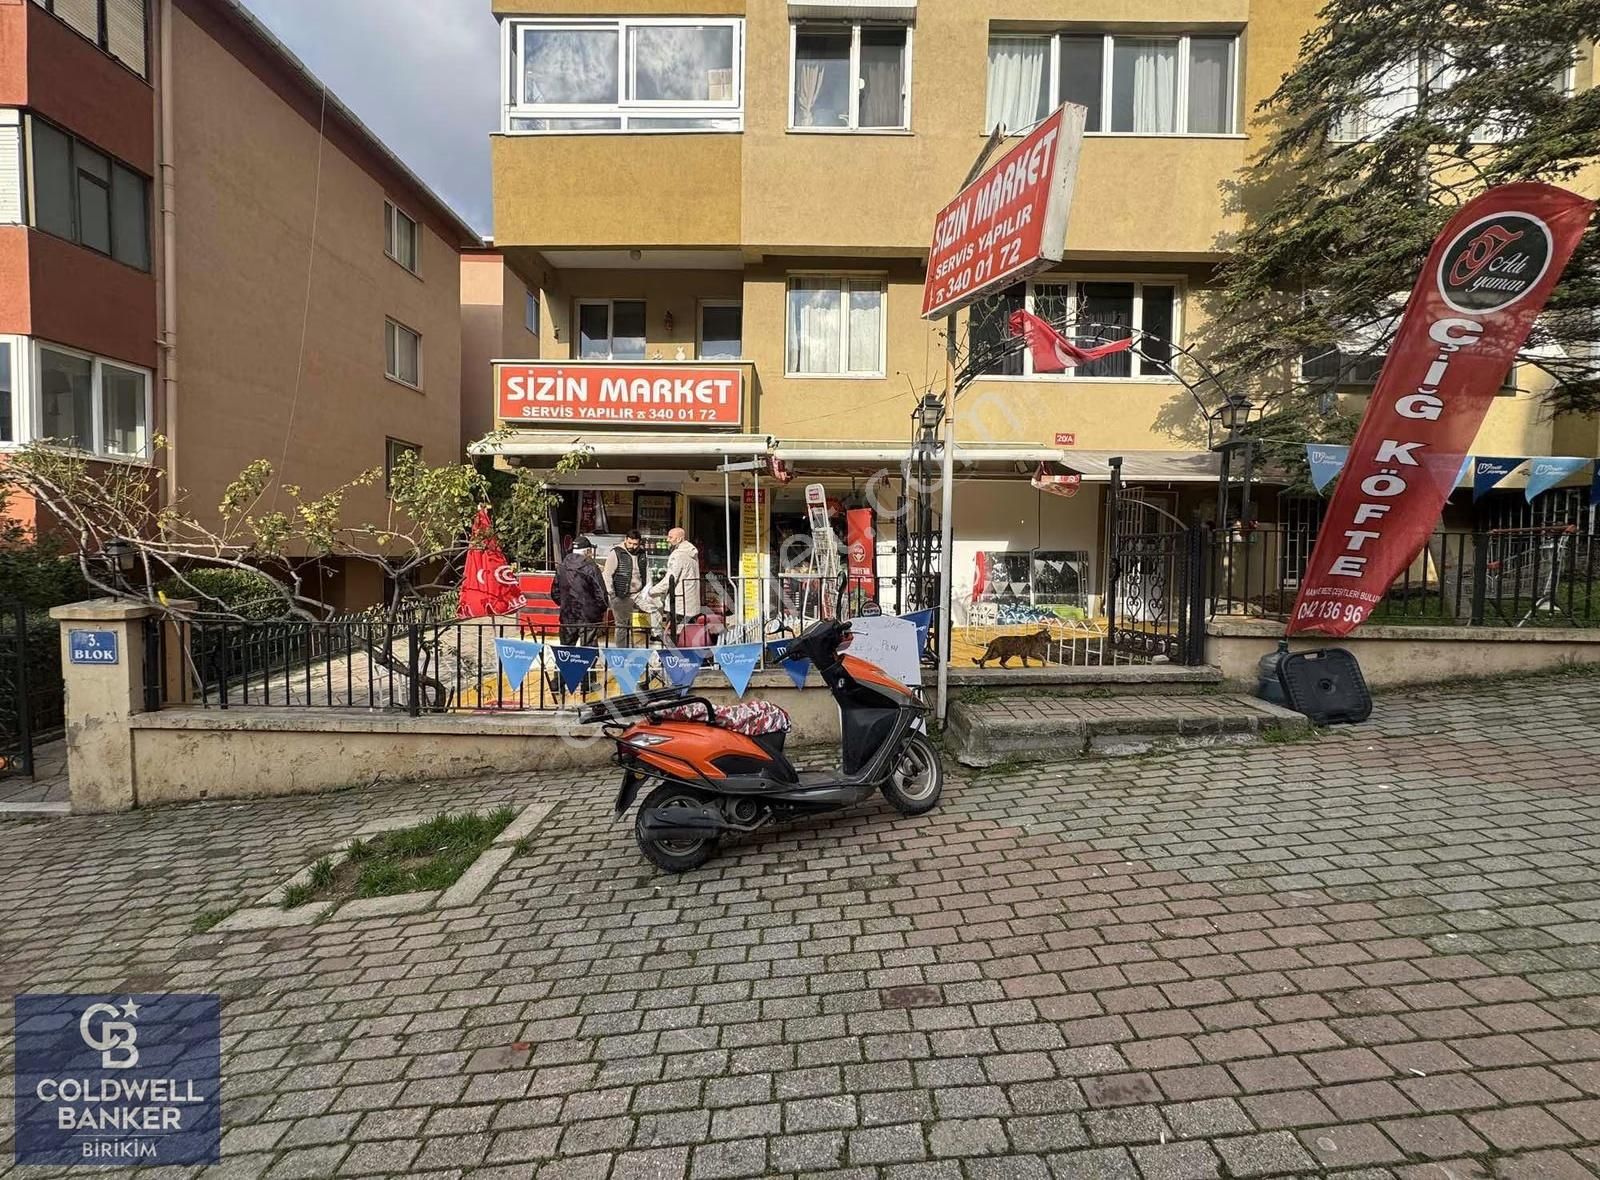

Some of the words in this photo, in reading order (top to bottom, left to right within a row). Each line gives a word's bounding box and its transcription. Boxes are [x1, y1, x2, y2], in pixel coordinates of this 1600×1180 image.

[932, 196, 972, 257] SİZİN
[971, 127, 1058, 230] MARKET
[935, 243, 974, 281] SERVİS
[978, 204, 1033, 254] YAPILIR
[946, 267, 971, 299] 340
[974, 253, 993, 282] 01
[1000, 237, 1022, 270] 72
[1465, 275, 1527, 293] yaman
[506, 369, 588, 402] SİZİN
[599, 376, 733, 404] MARKET
[521, 405, 574, 418] SERVİS
[578, 406, 633, 419] YAPILIR
[649, 407, 674, 420] 340
[678, 408, 694, 420] 01
[699, 409, 717, 420] 72
[1056, 435, 1074, 443] 20/A
[1327, 439, 1428, 578] KÖFTE
[1343, 604, 1364, 624] 96
[87, 633, 100, 647] 3.
[73, 649, 114, 660] BLOK
